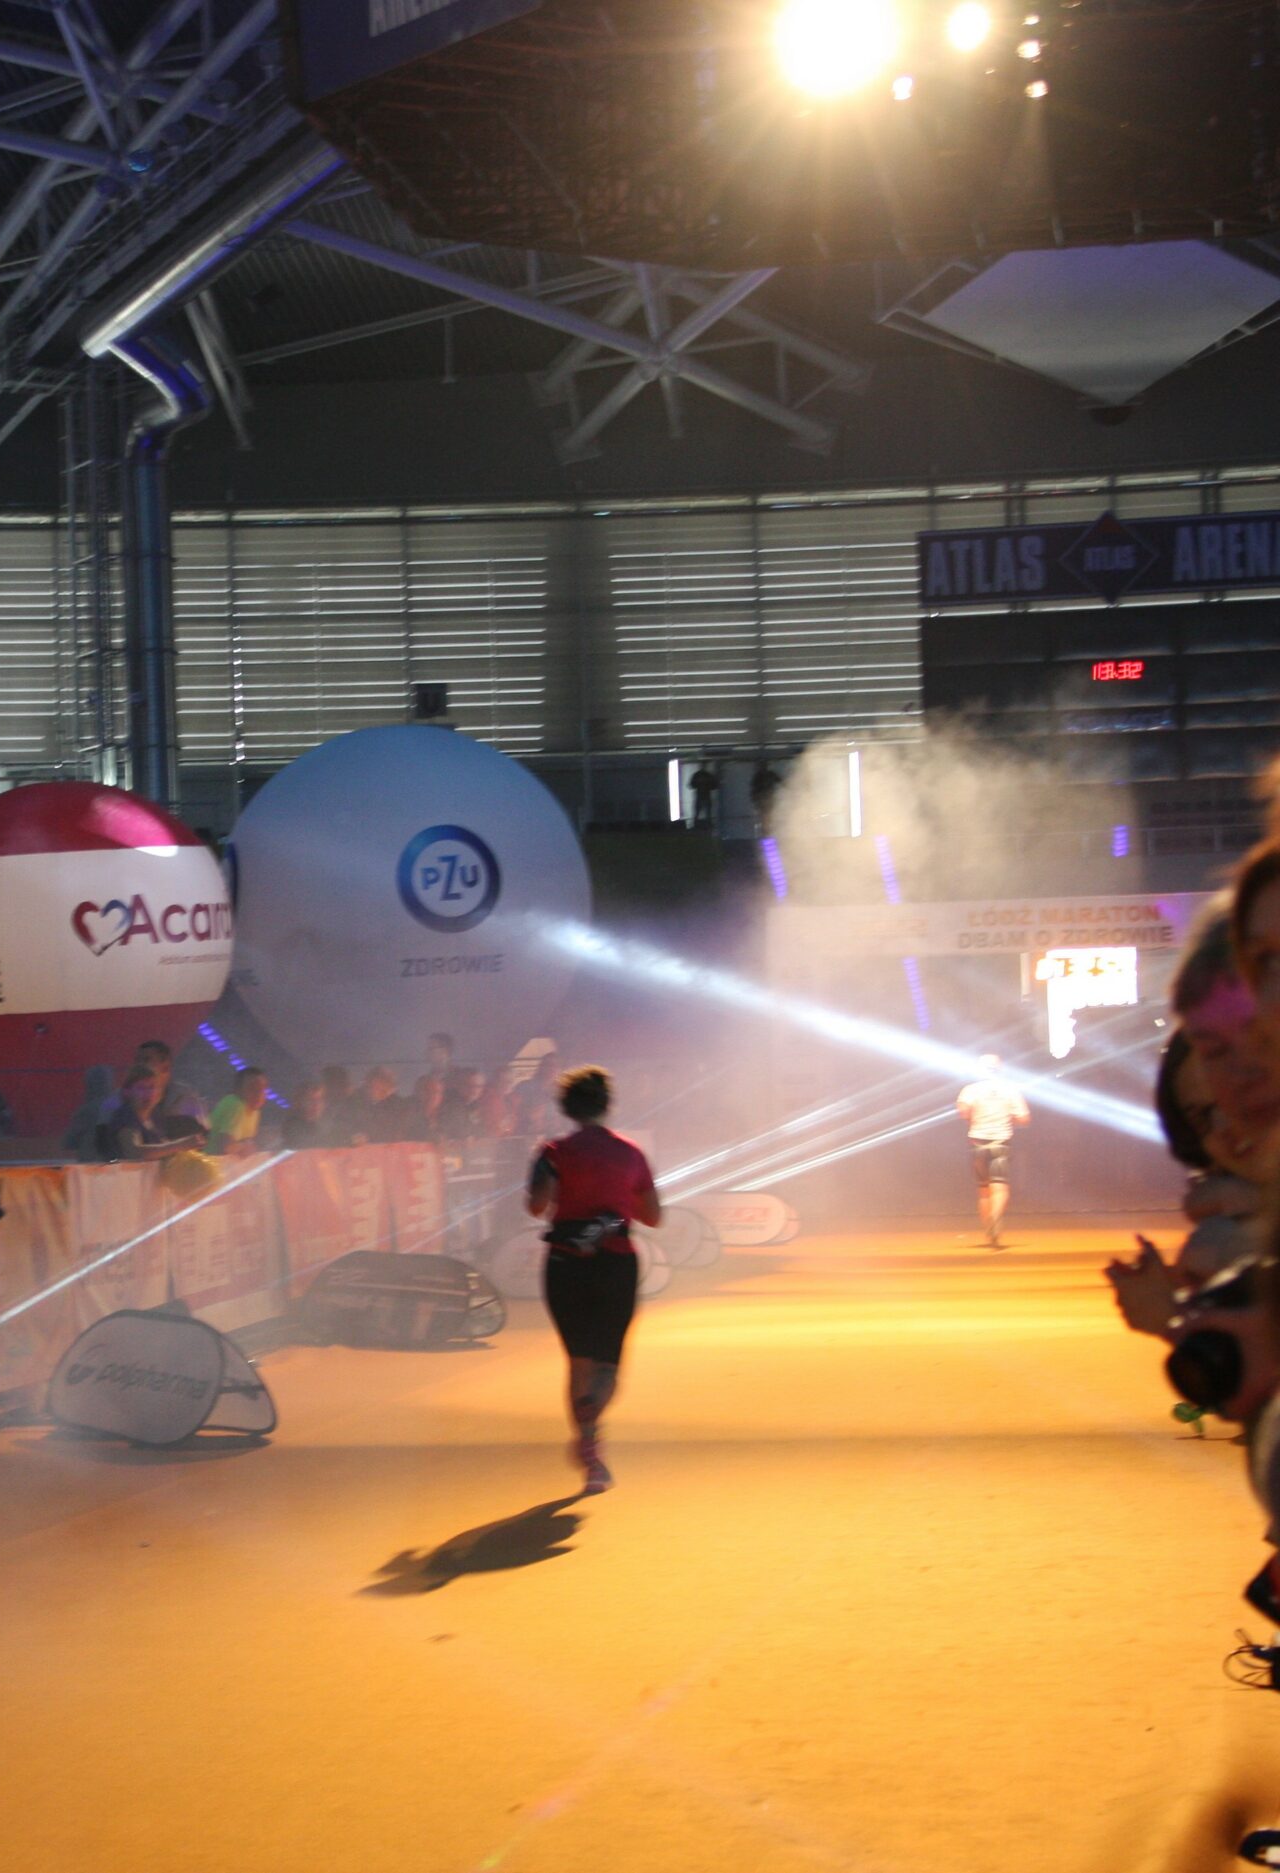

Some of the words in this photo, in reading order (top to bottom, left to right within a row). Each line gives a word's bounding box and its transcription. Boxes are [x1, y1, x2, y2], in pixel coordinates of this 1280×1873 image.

[926, 536, 1047, 597] ATLAS
[1038, 903, 1161, 926] MARATON
[1061, 924, 1174, 948] ZDROWIE
[400, 953, 506, 979] ZDROWIE
